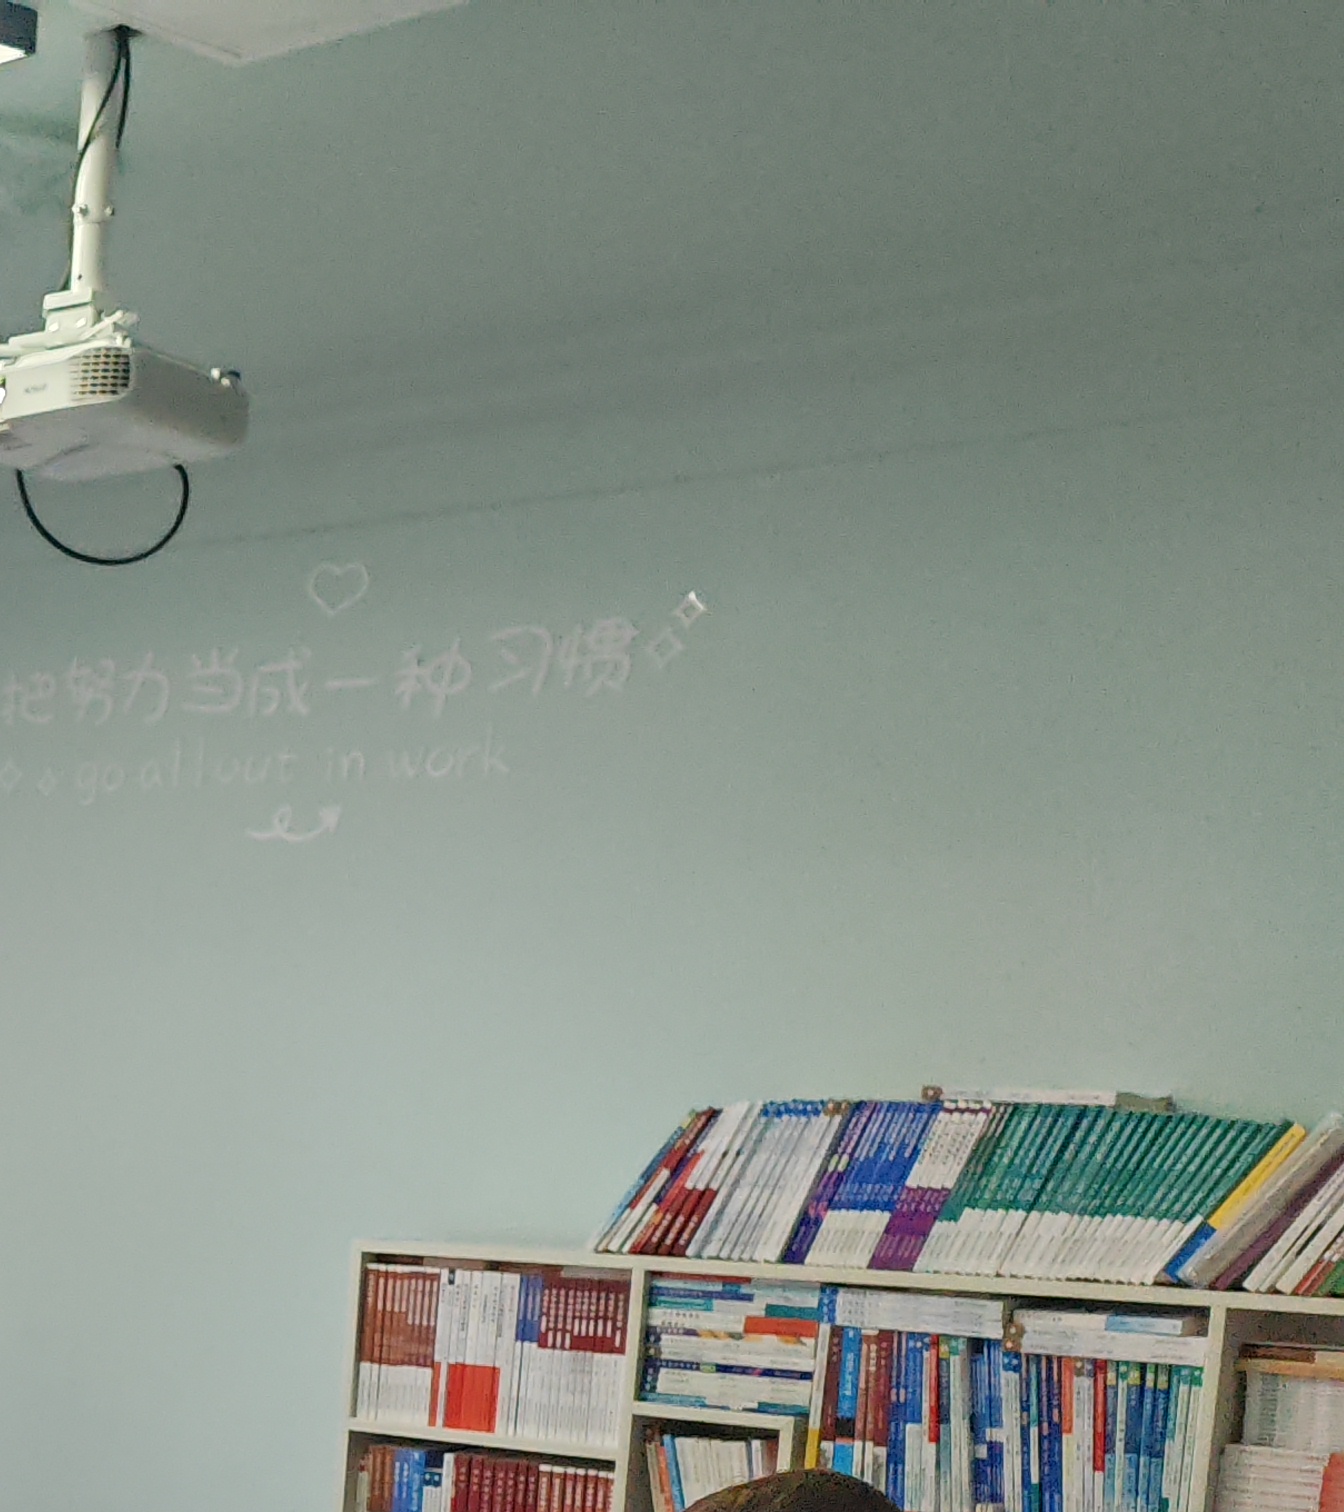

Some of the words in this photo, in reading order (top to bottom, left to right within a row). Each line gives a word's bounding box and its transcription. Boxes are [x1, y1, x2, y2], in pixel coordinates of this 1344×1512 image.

[1, 616, 640, 725] 把努力当成一种习惯
[78, 761, 125, 805] go
[323, 747, 365, 782] in
[384, 724, 511, 780] work
